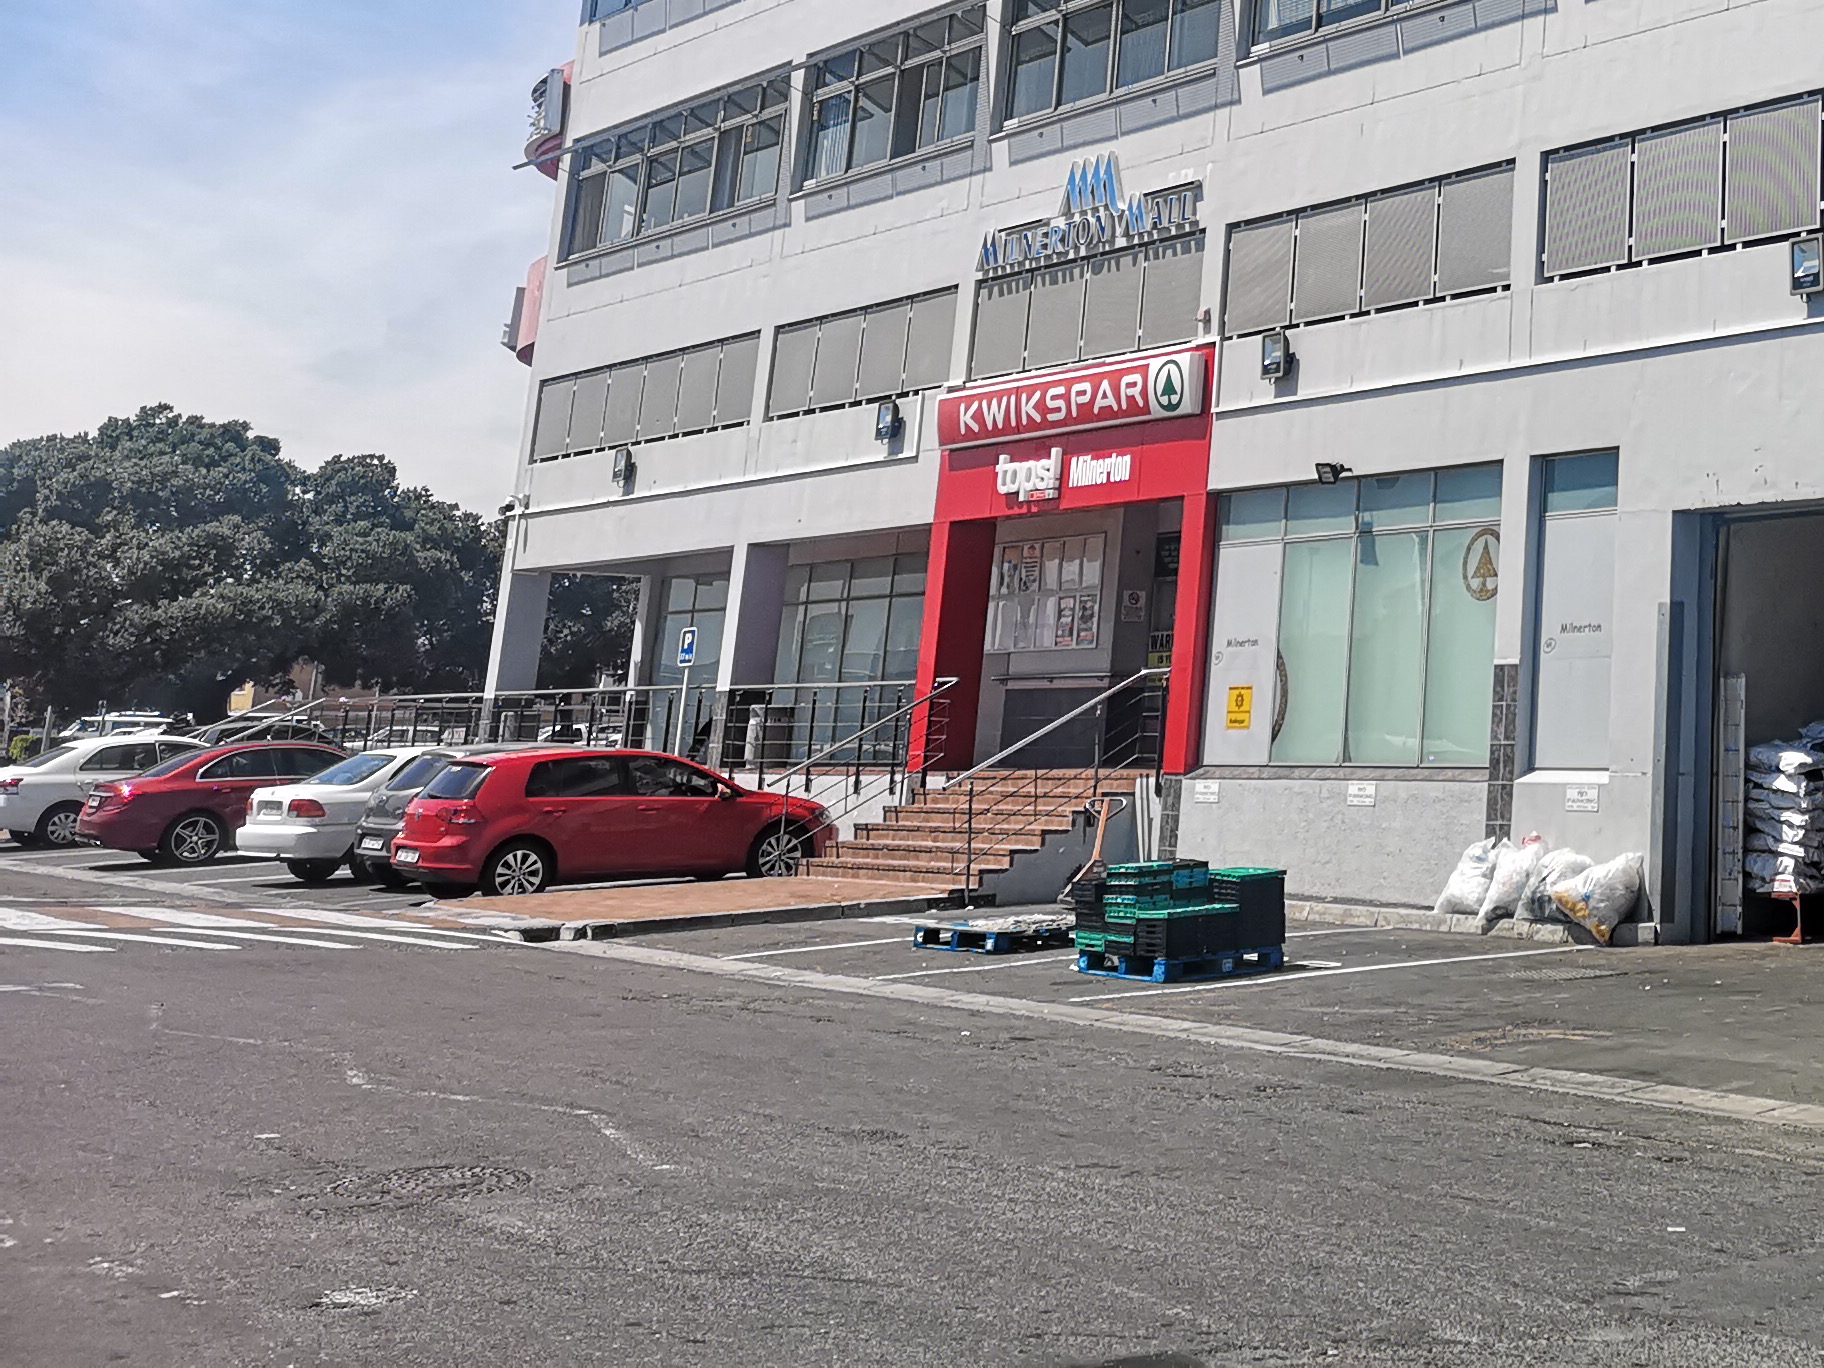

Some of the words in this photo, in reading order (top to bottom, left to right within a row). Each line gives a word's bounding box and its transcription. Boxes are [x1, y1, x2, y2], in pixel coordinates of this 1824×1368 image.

[976, 210, 1112, 272] MILNERTON
[1119, 192, 1197, 236] MALL
[959, 373, 1145, 435] KWIKSPAR
[995, 447, 1063, 502] tops!
[1068, 453, 1131, 488] Milnerton
[1559, 622, 1602, 634] Milnerton
[684, 633, 693, 649] P
[1150, 633, 1174, 650] WAR
[1225, 637, 1259, 648] Milnerton
